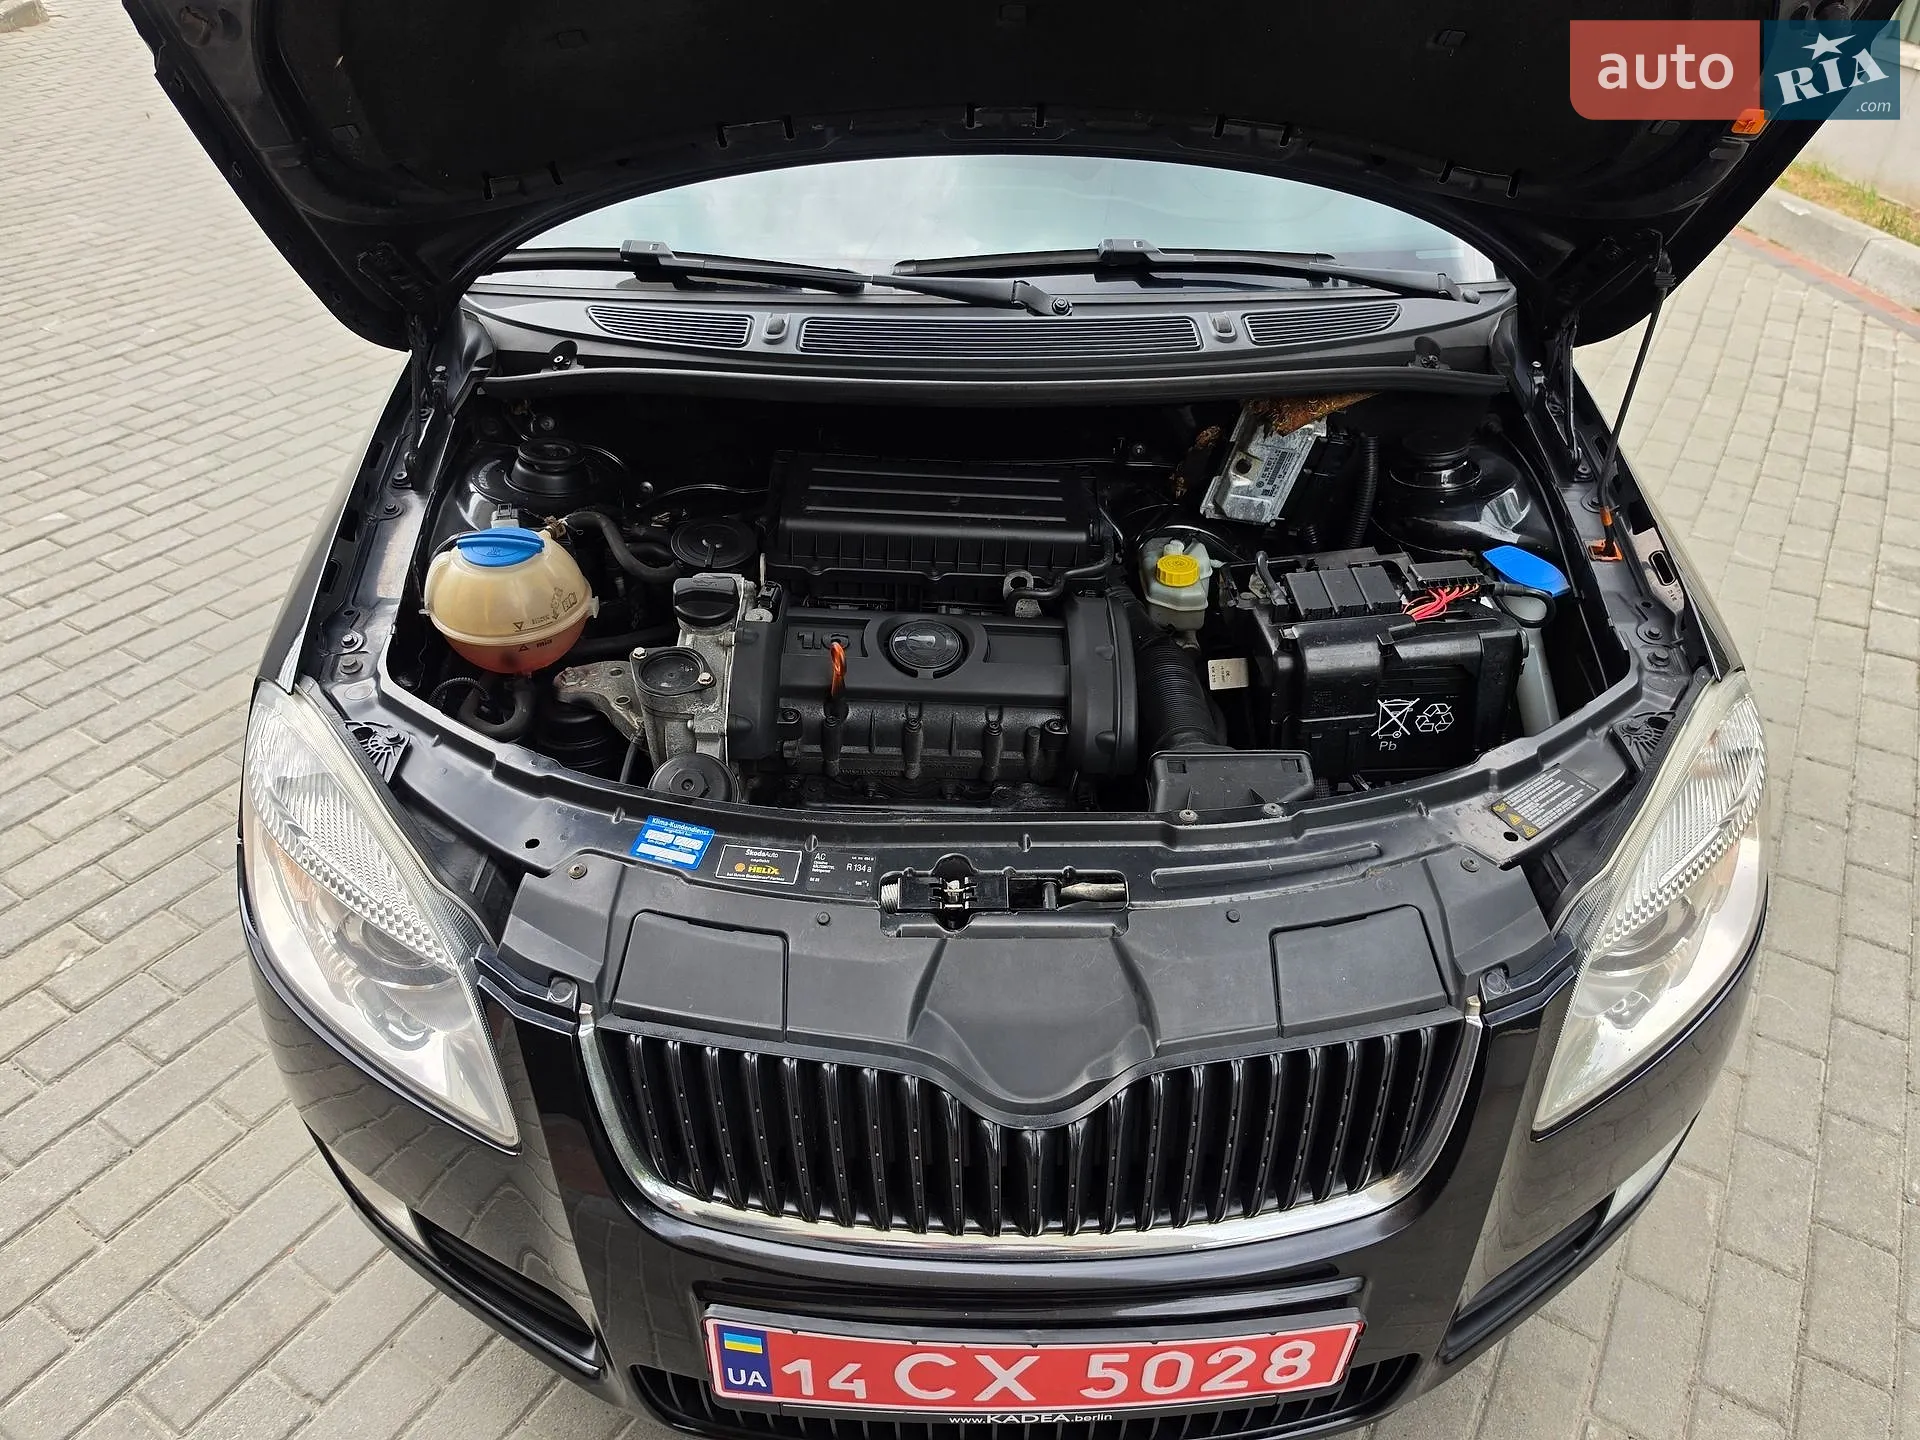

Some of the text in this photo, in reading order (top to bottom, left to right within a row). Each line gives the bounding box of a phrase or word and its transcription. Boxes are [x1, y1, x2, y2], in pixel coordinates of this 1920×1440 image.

[1379, 740, 1397, 751] Pb
[652, 817, 710, 835] Klima-Kundendienst
[814, 852, 826, 860] AC
[748, 864, 780, 875] HELIX
[781, 1340, 1316, 1401] 14 CX 5028
[727, 1367, 767, 1388] UA
[949, 1413, 1113, 1424] www.KADEA.berlin
